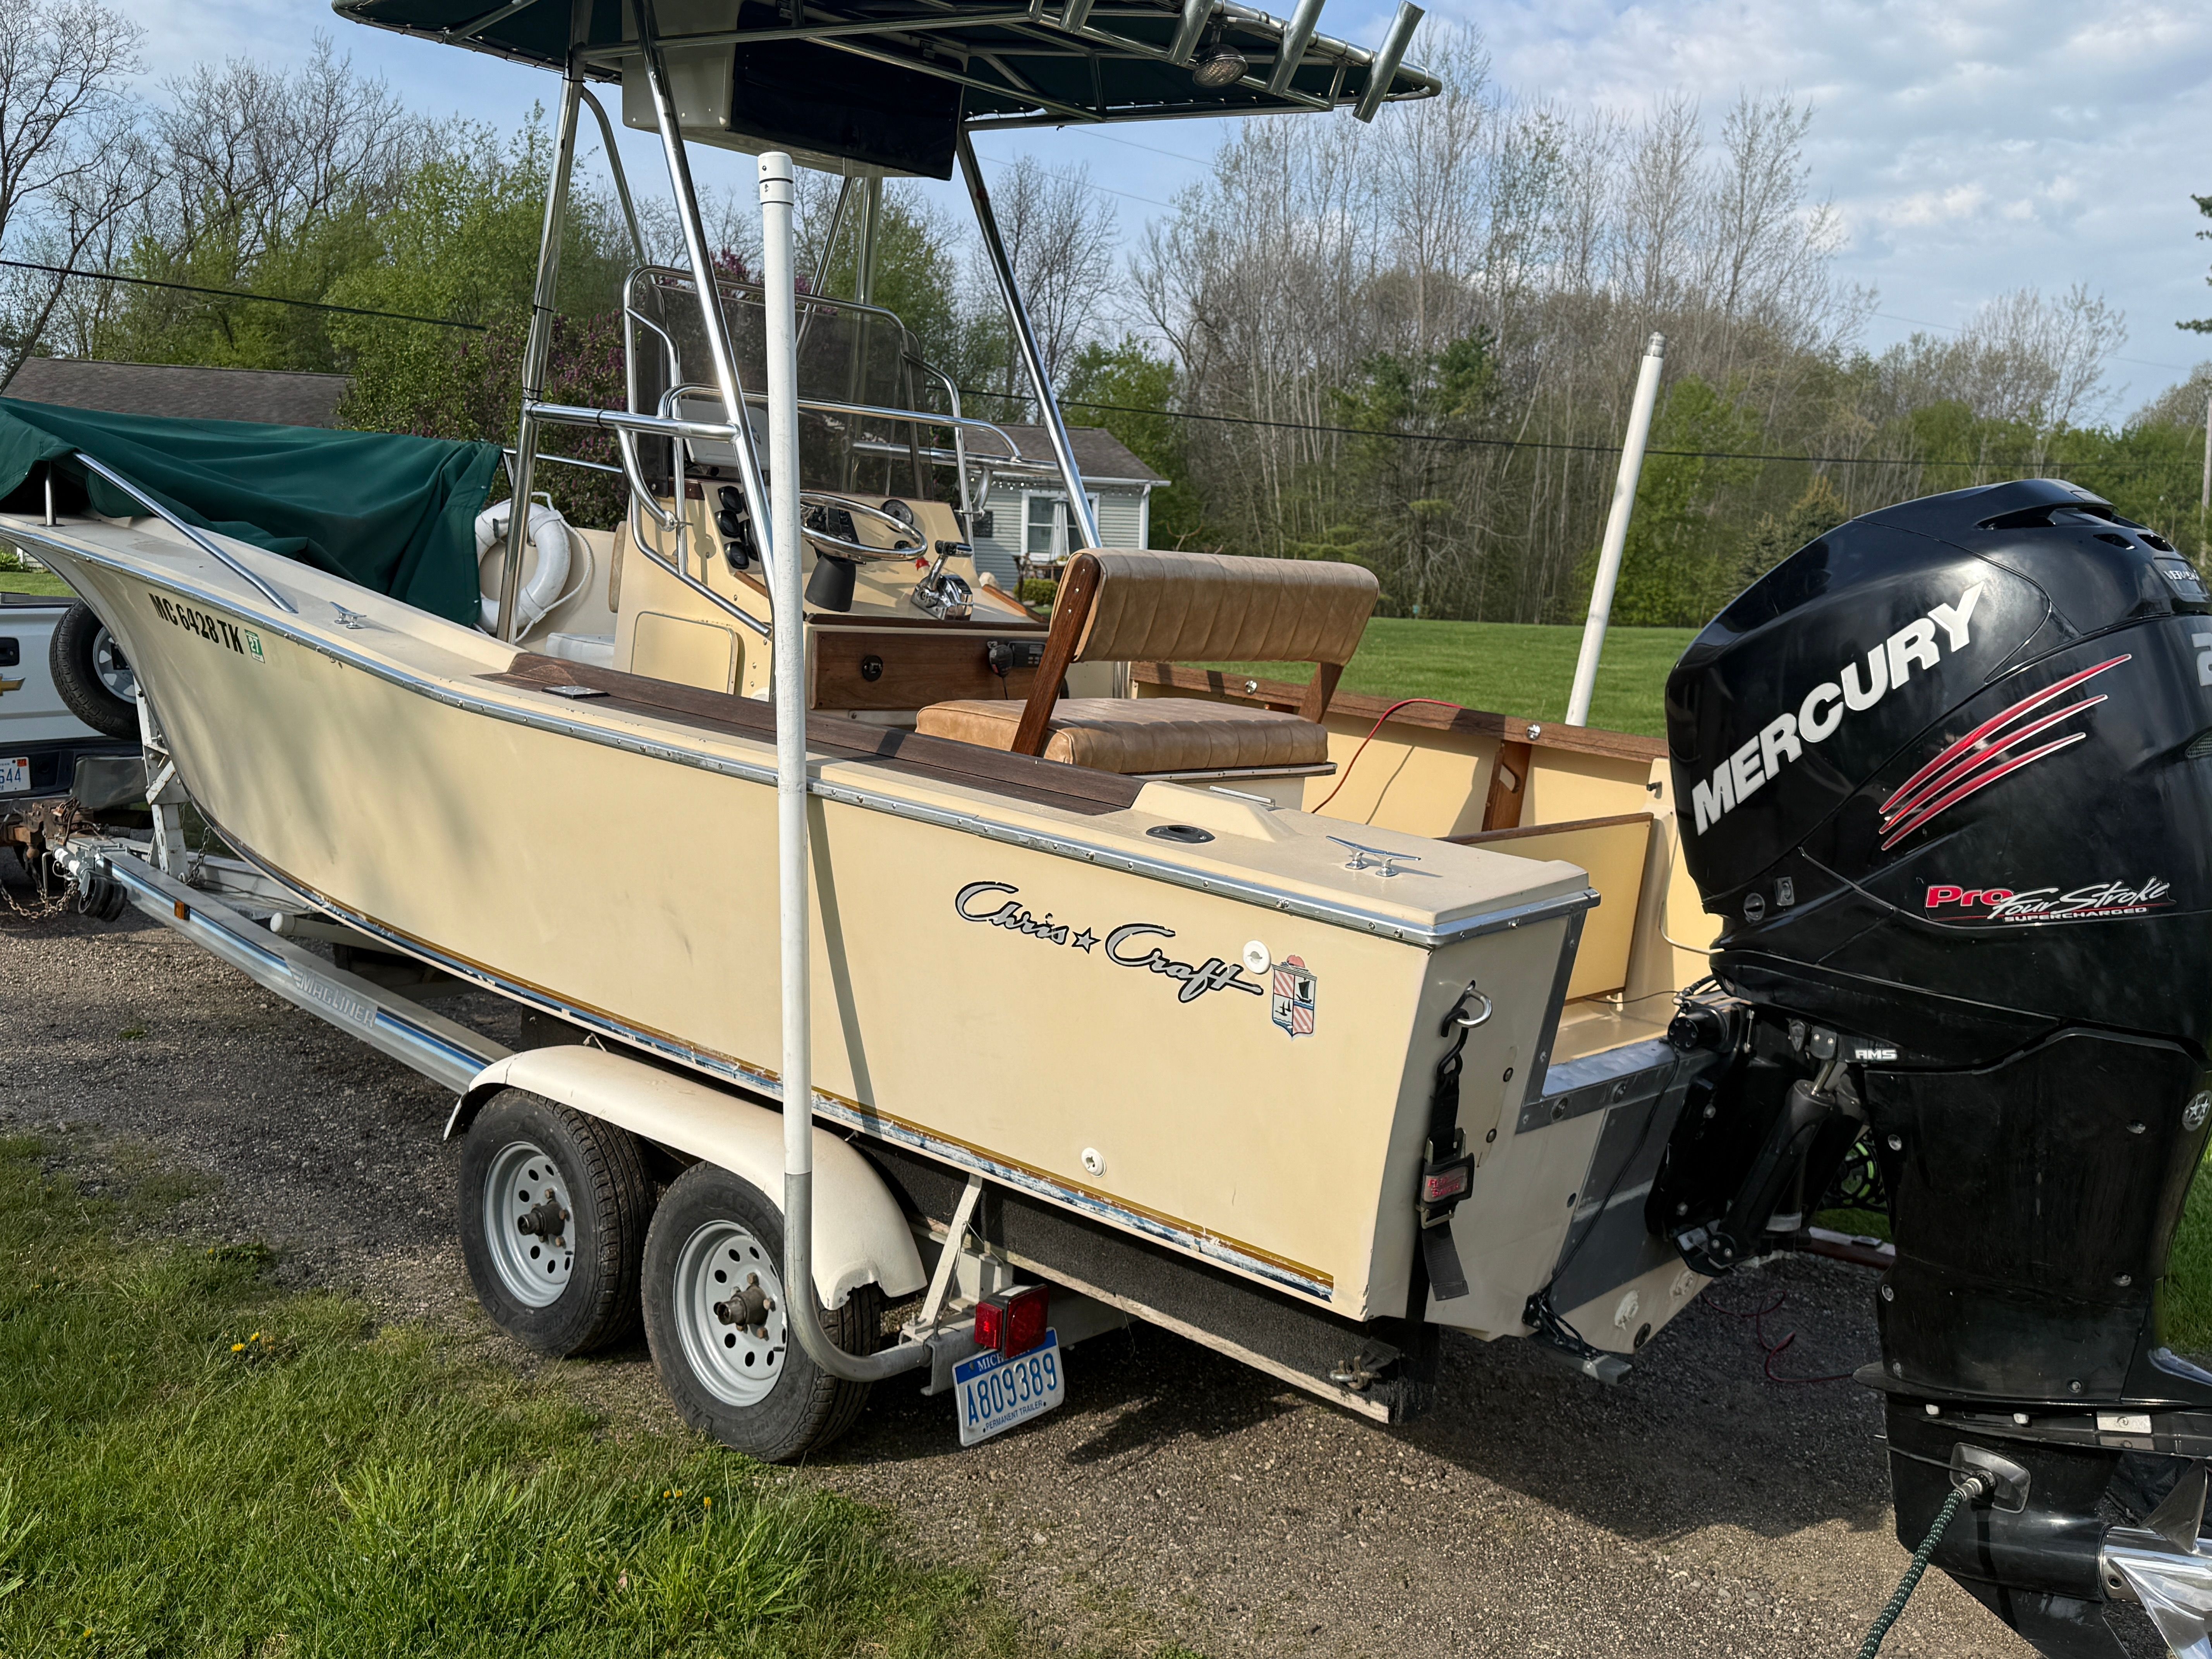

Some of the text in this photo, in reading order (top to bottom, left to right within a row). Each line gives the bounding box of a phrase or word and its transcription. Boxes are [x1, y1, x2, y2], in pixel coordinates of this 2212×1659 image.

[148, 592, 244, 654] MC 6428 TK
[1692, 580, 1985, 836] MERCURY
[1925, 885, 2014, 908] Pro
[2004, 907, 2147, 922] SUPERCHARGED
[955, 881, 1264, 1003] Chris Craft
[1855, 1049, 1897, 1060] AMS
[967, 1353, 1057, 1426] A809389
[986, 1400, 1043, 1431] PERMANENT TRAILER
